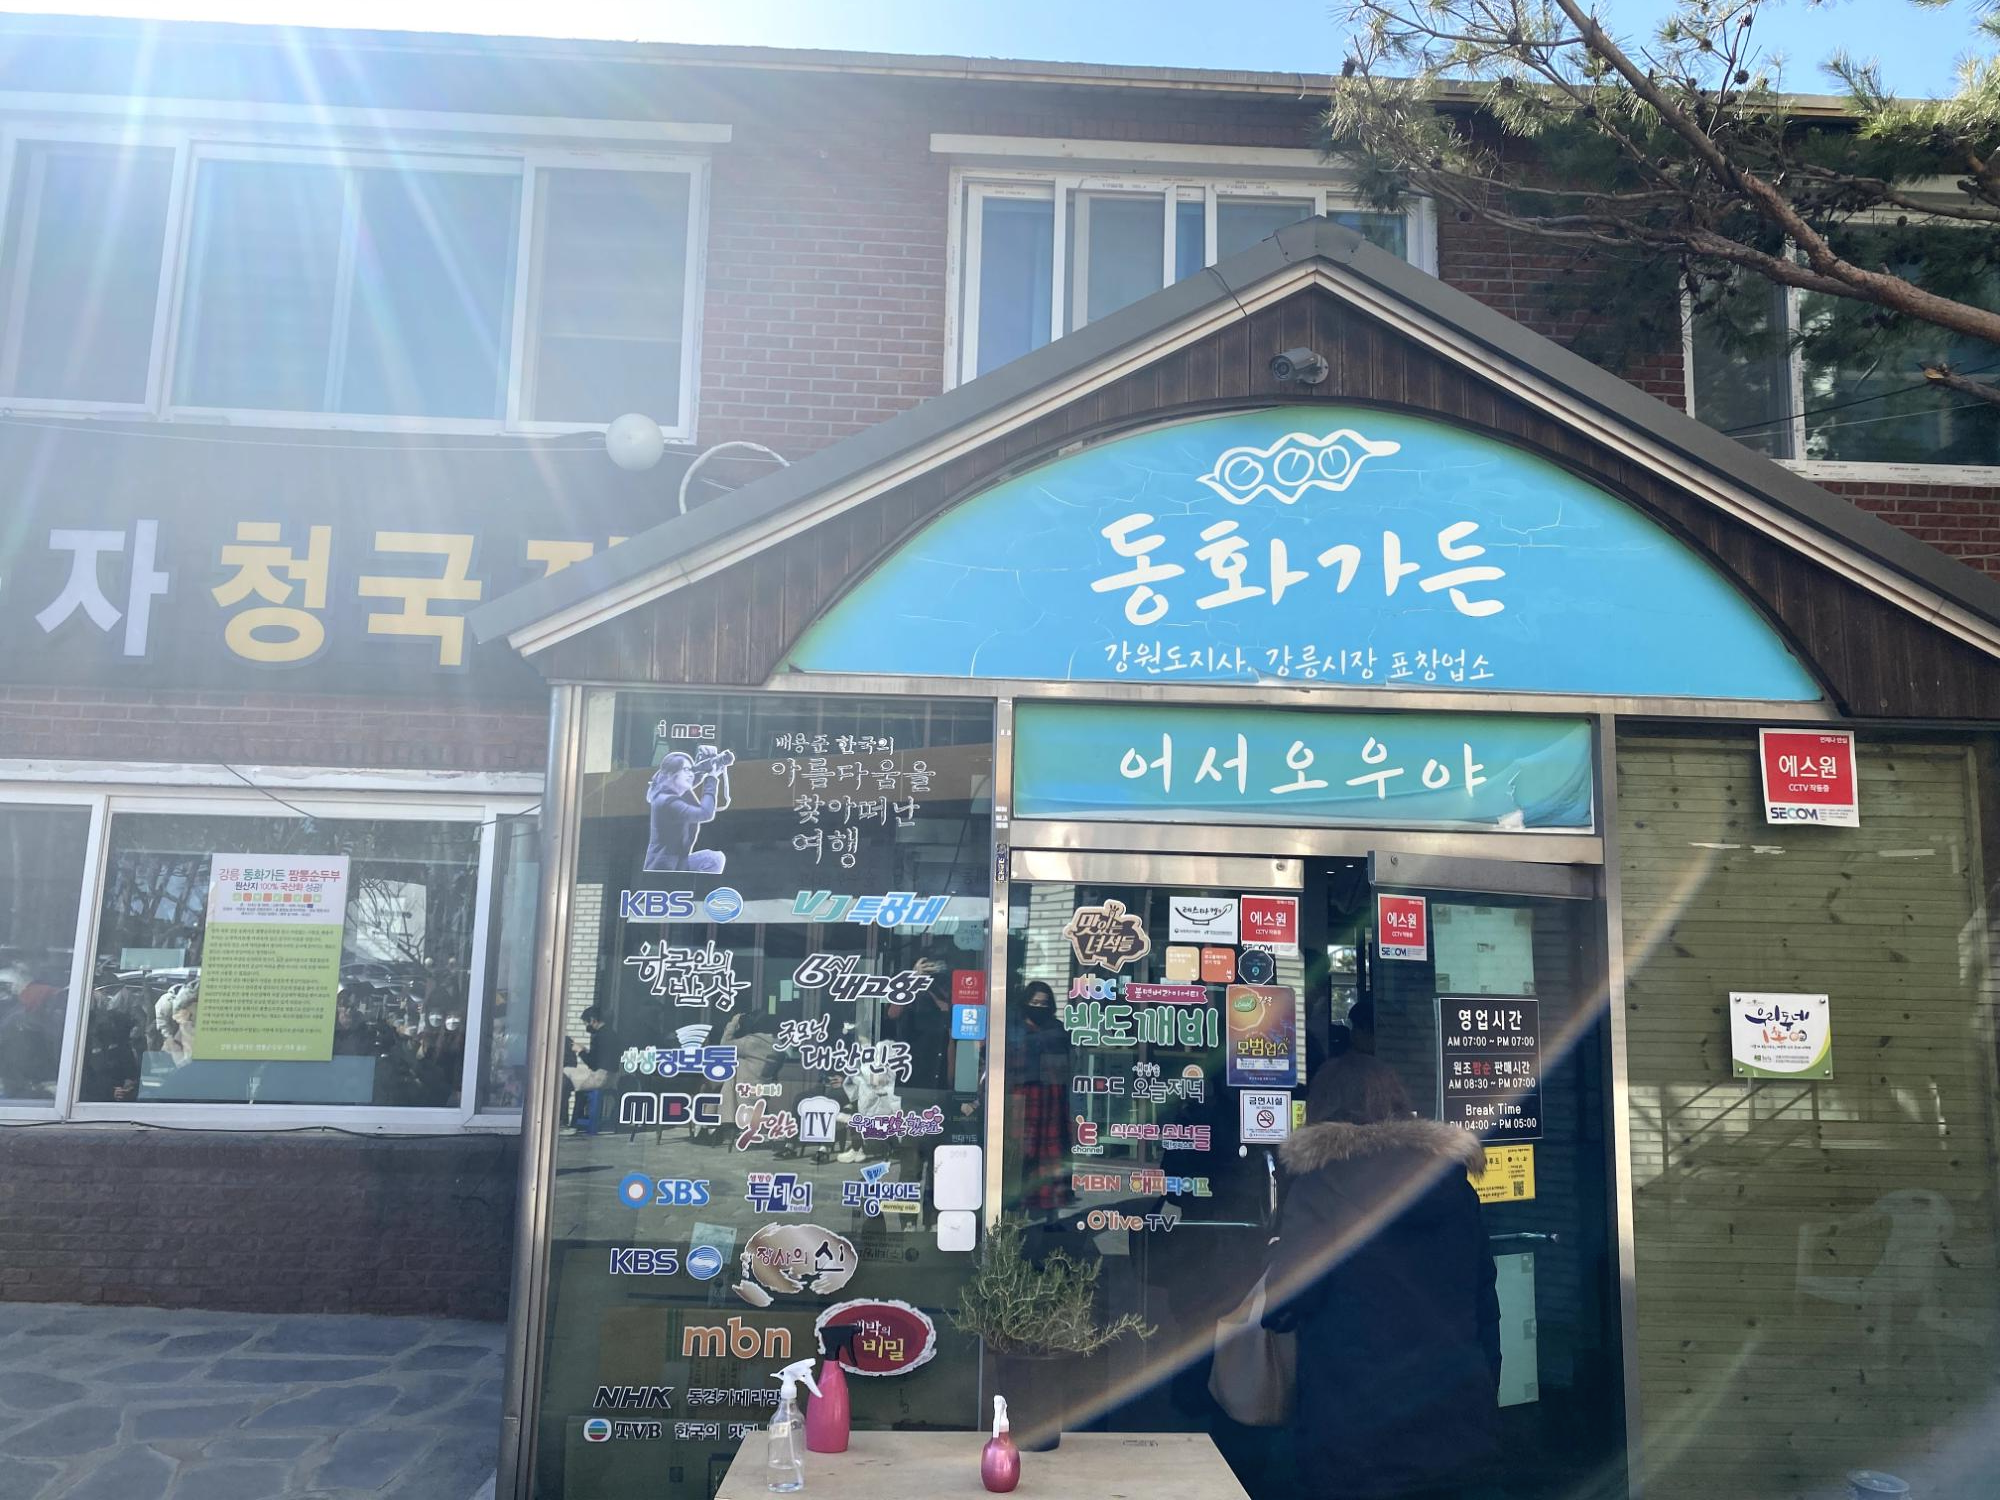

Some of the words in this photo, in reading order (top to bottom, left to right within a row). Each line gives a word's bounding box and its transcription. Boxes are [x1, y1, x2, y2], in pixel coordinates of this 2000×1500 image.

[1090, 513, 1506, 626] 동화가든
[1266, 645, 1378, 678] 강릉시장
[1391, 649, 1495, 682] 표창업소
[775, 733, 831, 753] 배용준
[835, 735, 894, 755] 한국의
[771, 758, 937, 792] 아름다움을
[1120, 732, 1487, 800] 어서오우야
[1779, 755, 1837, 778] 에스원
[1788, 783, 1808, 792] CCTV
[1771, 806, 1818, 820] SECOM
[793, 826, 859, 868] 여행
[218, 868, 239, 881] 강릉
[243, 868, 285, 881] 동화가든
[235, 882, 258, 891] 원산지
[260, 883, 279, 891] 100%
[620, 890, 695, 918] KBS
[792, 890, 853, 922] VJ
[845, 892, 951, 928] 특공대
[1075, 911, 1123, 936] 맛있는
[1250, 911, 1287, 927] 에스원
[1387, 912, 1417, 929] 에스원
[1085, 935, 1136, 955] 녀석들
[1381, 948, 1407, 957] SECOM
[624, 940, 733, 995] 한국인의
[1064, 1002, 1218, 1047] 밤도깨비
[1458, 1009, 1523, 1031] 영업시간
[1744, 1005, 1810, 1031] 우리동네
[773, 1013, 830, 1051] 굿모닝
[1447, 1037, 1460, 1046] AM
[1462, 1036, 1487, 1046] 07:00
[1497, 1036, 1509, 1046] PM
[1511, 1036, 1534, 1046] 07:00
[1237, 1037, 1289, 1056] 모범업소
[621, 1046, 740, 1082] 생생정보통
[799, 1039, 912, 1083] 대한민국
[1132, 1062, 1160, 1077] 생방송
[1494, 1061, 1530, 1075] 판매시간
[1072, 1075, 1125, 1094] MBC
[1131, 1078, 1204, 1103] 오늘저녁
[1448, 1079, 1461, 1089] AM
[1463, 1079, 1488, 1089] 08:30
[1498, 1079, 1511, 1088] PM
[1513, 1078, 1536, 1088] 07:00
[619, 1092, 723, 1125] MBC
[1249, 1097, 1283, 1106] 금연시설
[1465, 1104, 1495, 1116] Break
[1498, 1103, 1521, 1114] Time
[736, 1098, 798, 1151] 맛있는
[805, 1112, 834, 1137] TV
[1464, 1120, 1488, 1130] 04:00
[1499, 1119, 1511, 1129] PM
[1514, 1118, 1537, 1128] 05:00
[1071, 1145, 1103, 1154] channel
[656, 1179, 710, 1206] SBS
[1072, 1174, 1121, 1192] MBN
[1129, 1170, 1213, 1197] 해피라이프
[744, 1181, 813, 1213] 투데이
[1145, 1214, 1178, 1232] TV
[610, 1248, 679, 1275] KBS
[757, 1246, 808, 1265] 장사의
[815, 1240, 845, 1272] 신
[682, 1316, 792, 1359] mbn
[862, 1335, 905, 1361] 비밀
[592, 1386, 675, 1409] NHK
[614, 1422, 663, 1440] TVB
[673, 1422, 721, 1441] 한국의
